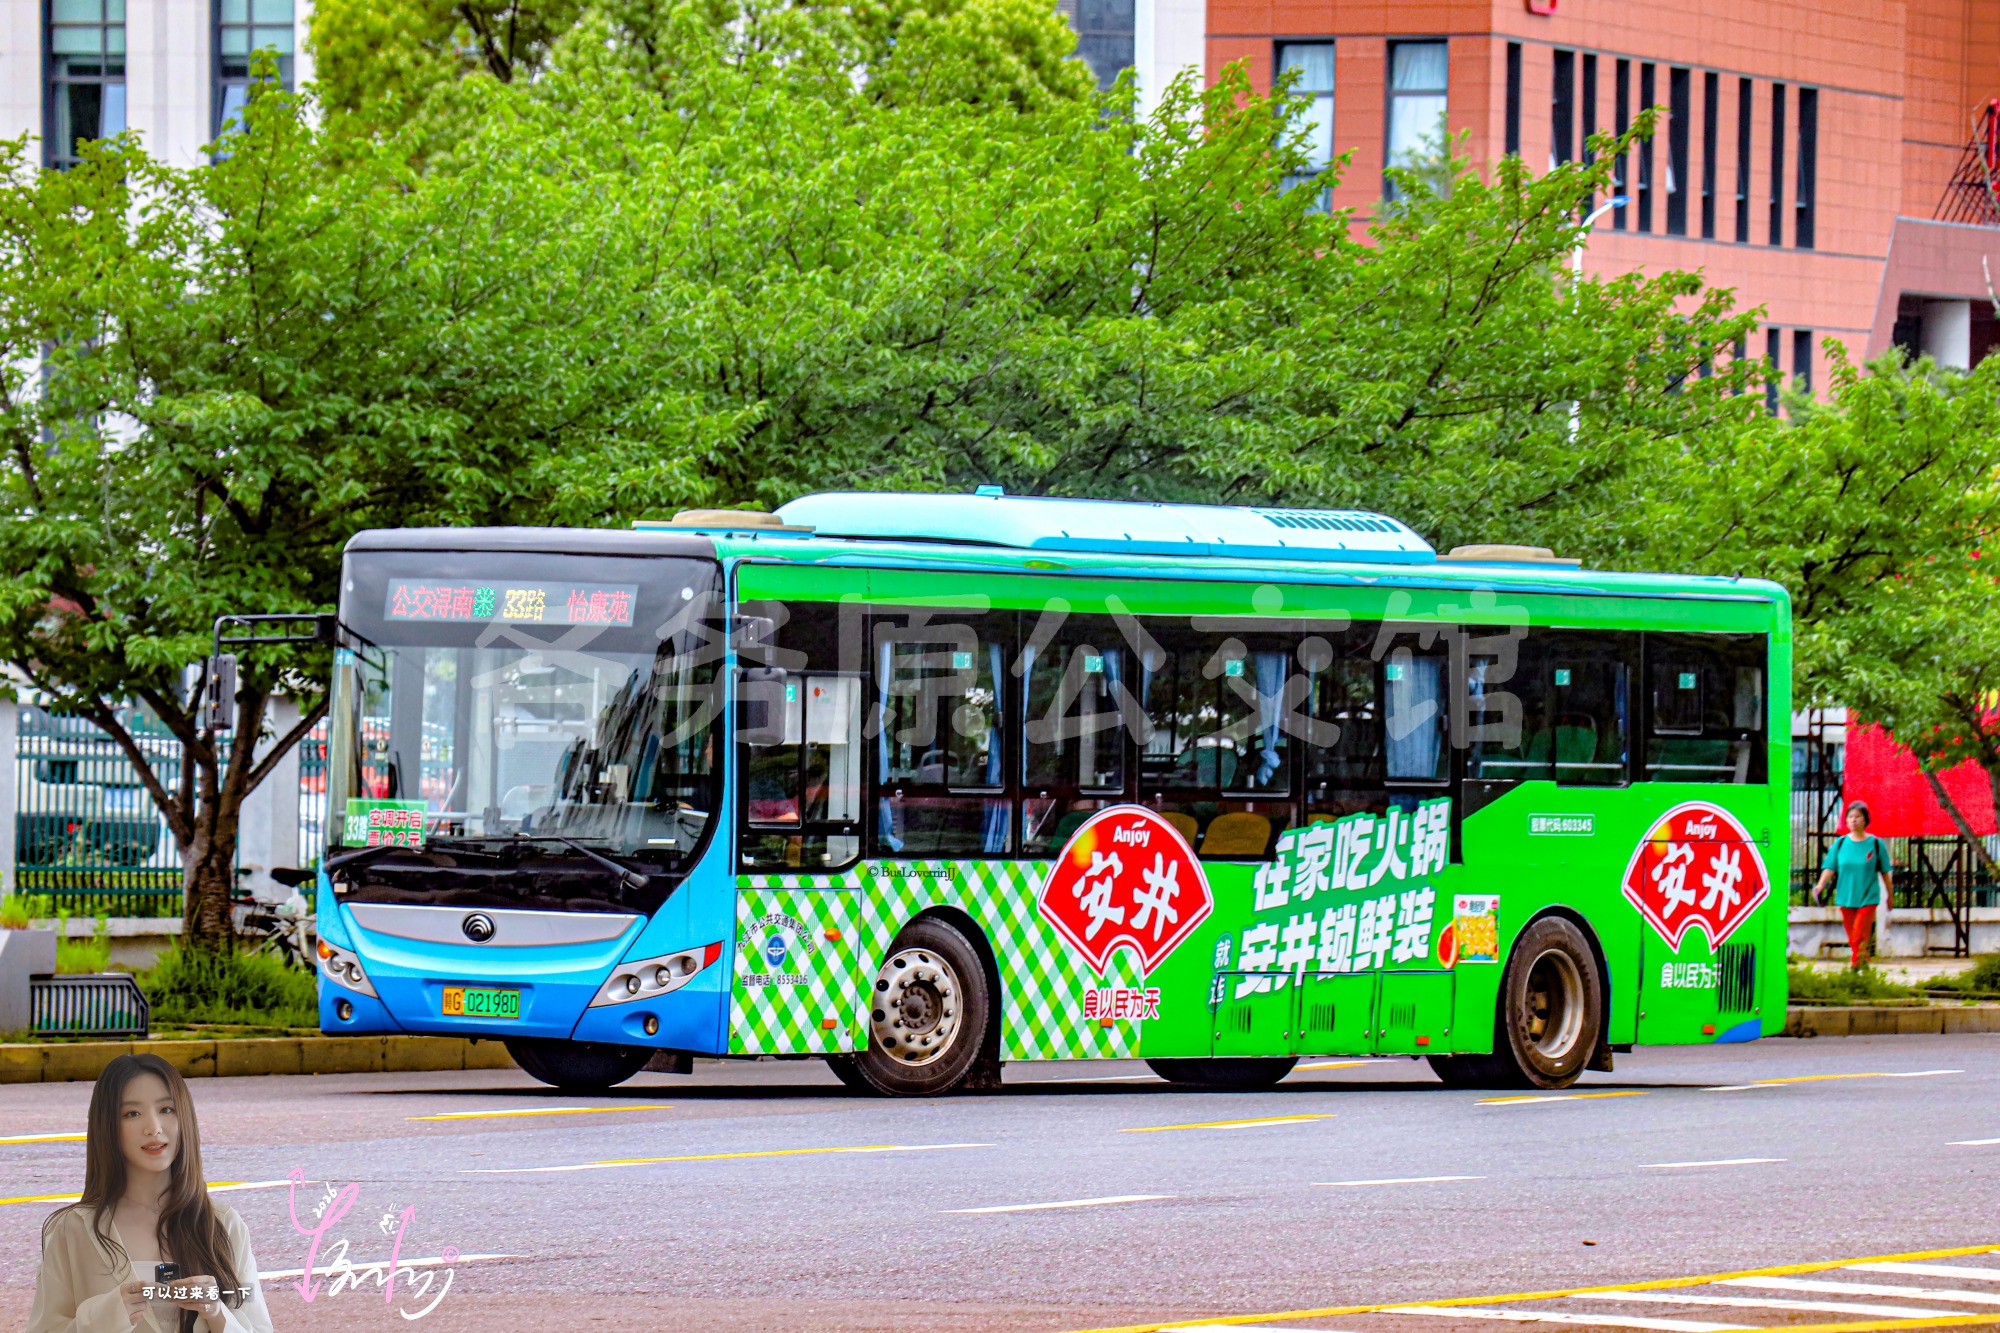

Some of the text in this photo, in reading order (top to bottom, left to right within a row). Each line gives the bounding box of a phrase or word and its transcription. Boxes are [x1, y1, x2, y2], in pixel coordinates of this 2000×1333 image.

[503, 588, 546, 621] 33路
[567, 589, 632, 623] 怡康苑
[369, 808, 423, 829] 空调开启
[1113, 820, 1150, 847] Anjoy
[1685, 815, 1717, 840] Anjoy
[367, 830, 421, 847] 票价2元
[1253, 801, 1450, 911] 在家吃火锅
[1072, 851, 1180, 942] 安井
[1651, 843, 1742, 921] 安井
[1234, 887, 1436, 999] 安井锁鲜装
[1083, 989, 1160, 1019] 食以民为天
